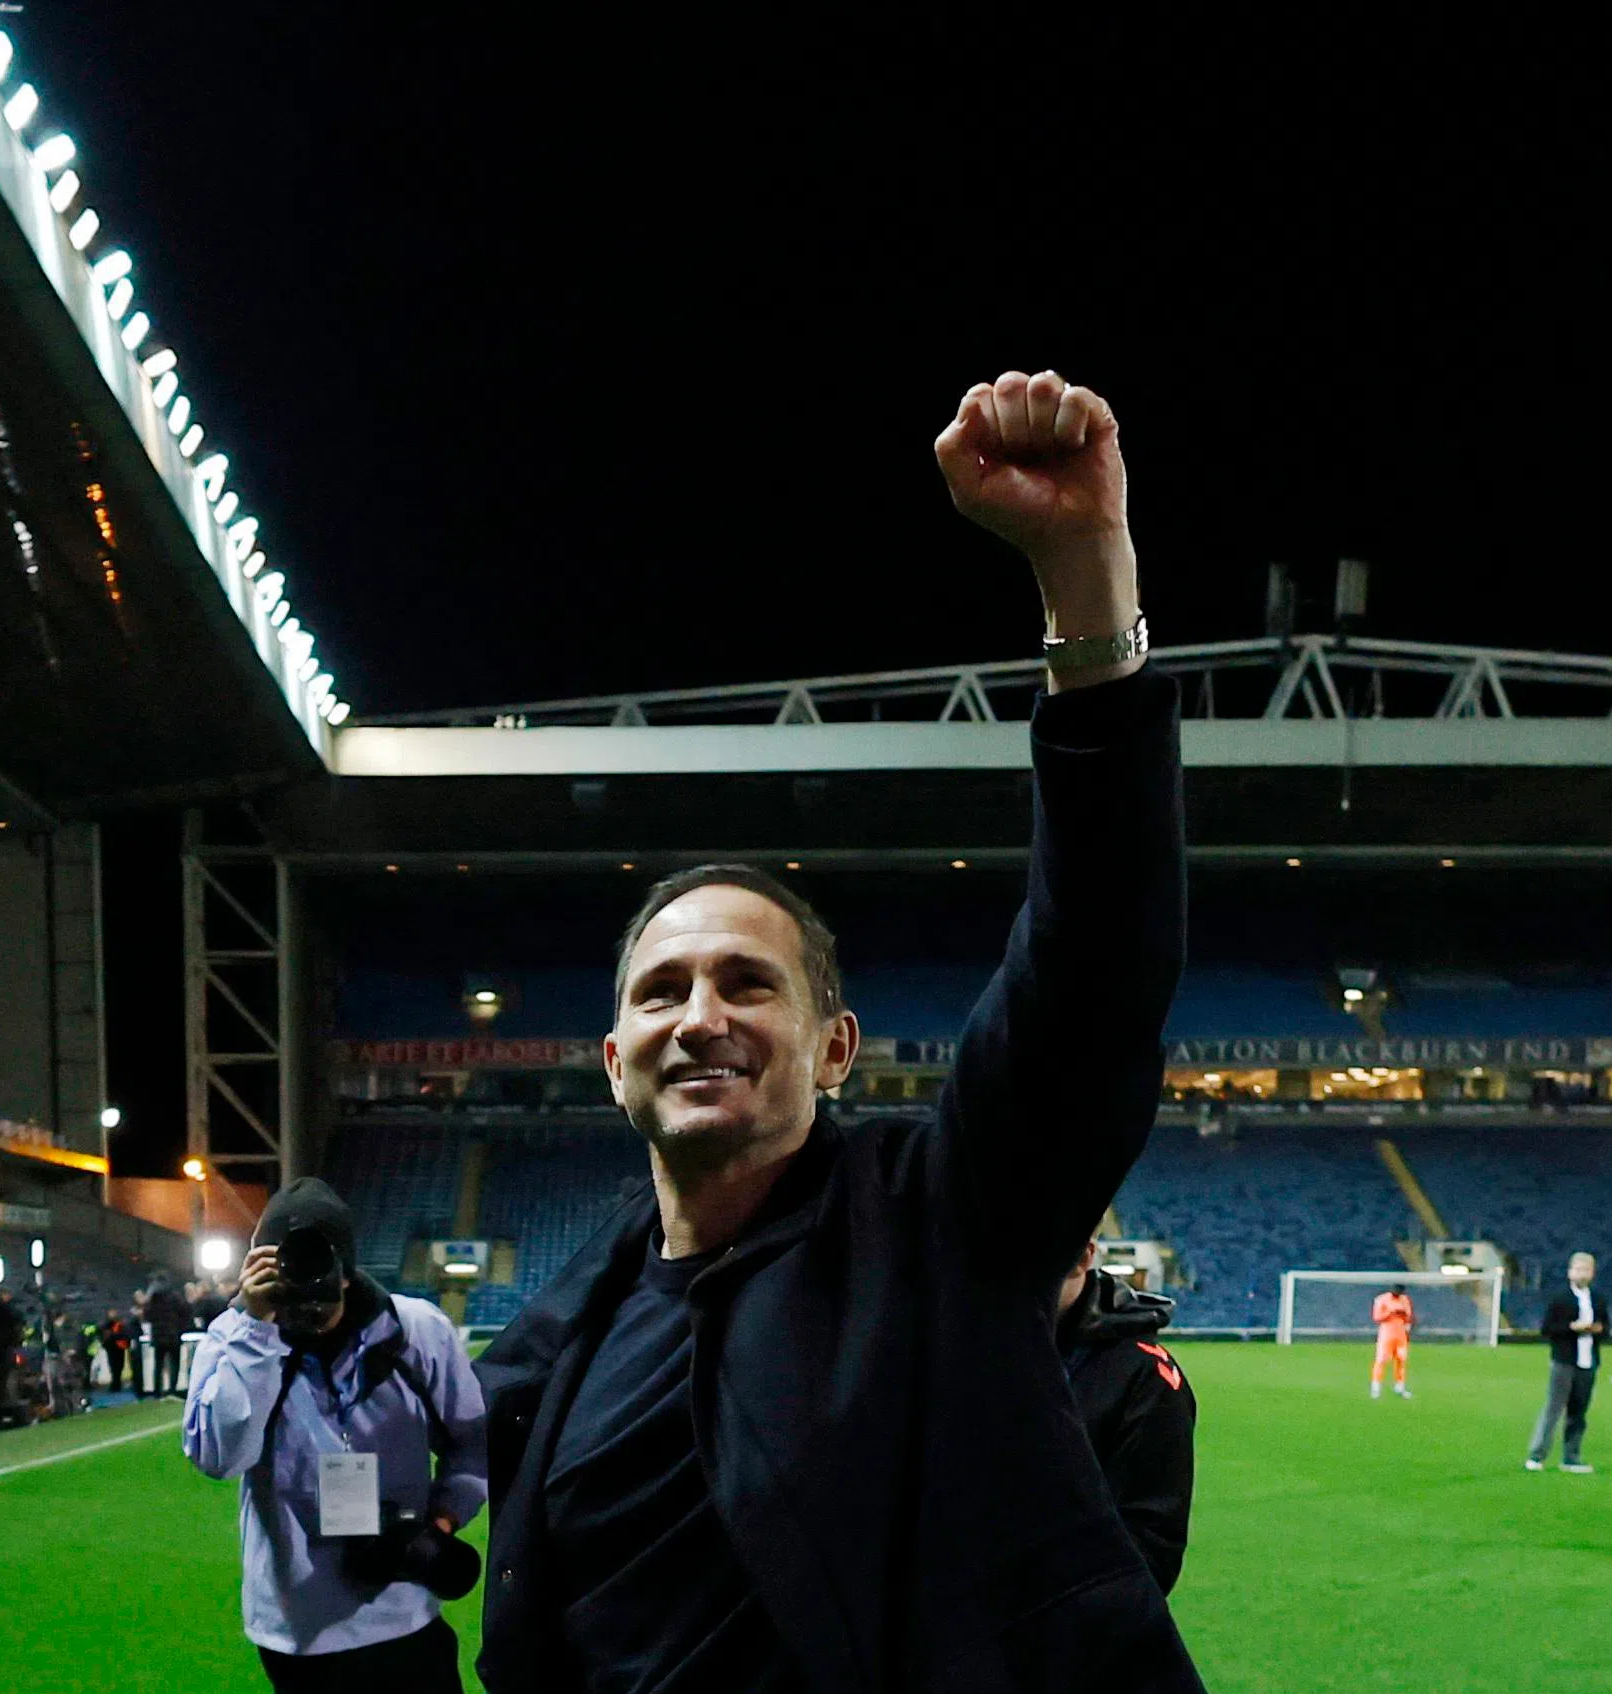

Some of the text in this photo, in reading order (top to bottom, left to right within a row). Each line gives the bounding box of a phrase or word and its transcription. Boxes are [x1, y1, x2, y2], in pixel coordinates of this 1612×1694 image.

[1172, 1039, 1280, 1061] AYTON
[1296, 1039, 1487, 1061] BLACKBURN
[1502, 1039, 1570, 1061] END
